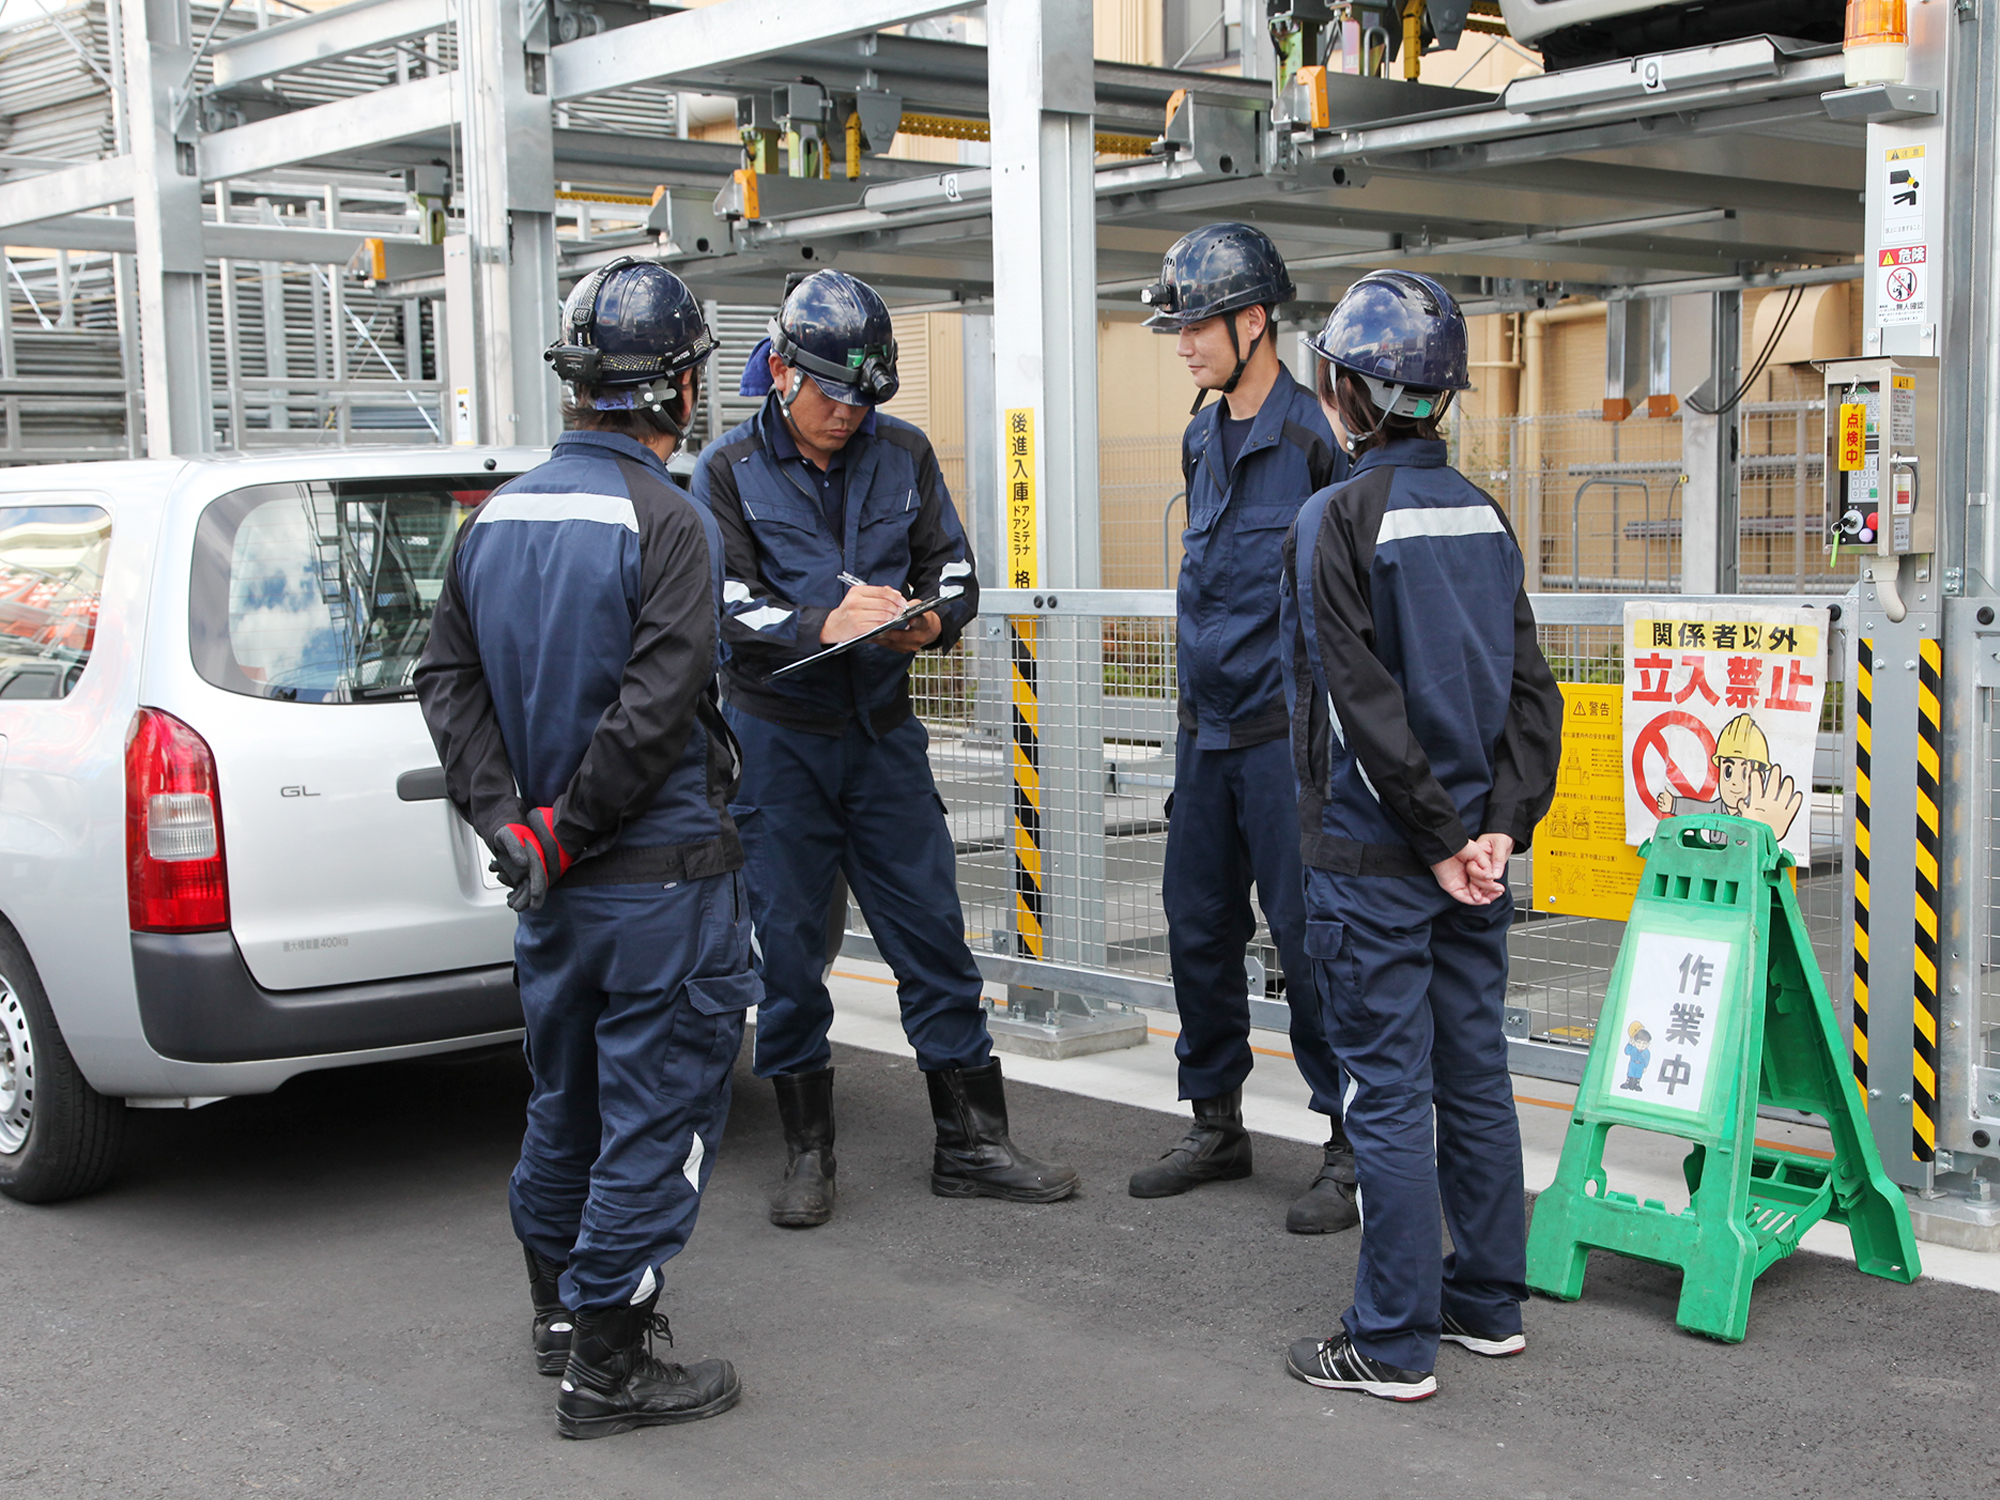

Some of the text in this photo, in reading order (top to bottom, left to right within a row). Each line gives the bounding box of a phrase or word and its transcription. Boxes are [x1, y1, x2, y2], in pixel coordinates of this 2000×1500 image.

[1645, 61, 1659, 89] 9
[1901, 148, 1919, 158] 注意
[947, 178, 957, 198] 8
[1898, 246, 1925, 264] 危険
[1846, 412, 1859, 465] 点検中
[1011, 412, 1029, 502] 後進入庫
[1013, 505, 1022, 568] ドアミラー
[1021, 505, 1030, 556] アンテナ
[1652, 622, 1798, 652] 関係者以外
[1632, 652, 1814, 713] 立入禁止
[1589, 701, 1610, 717] 警告
[280, 785, 321, 798] GL
[1657, 952, 1715, 1096] 作業中
